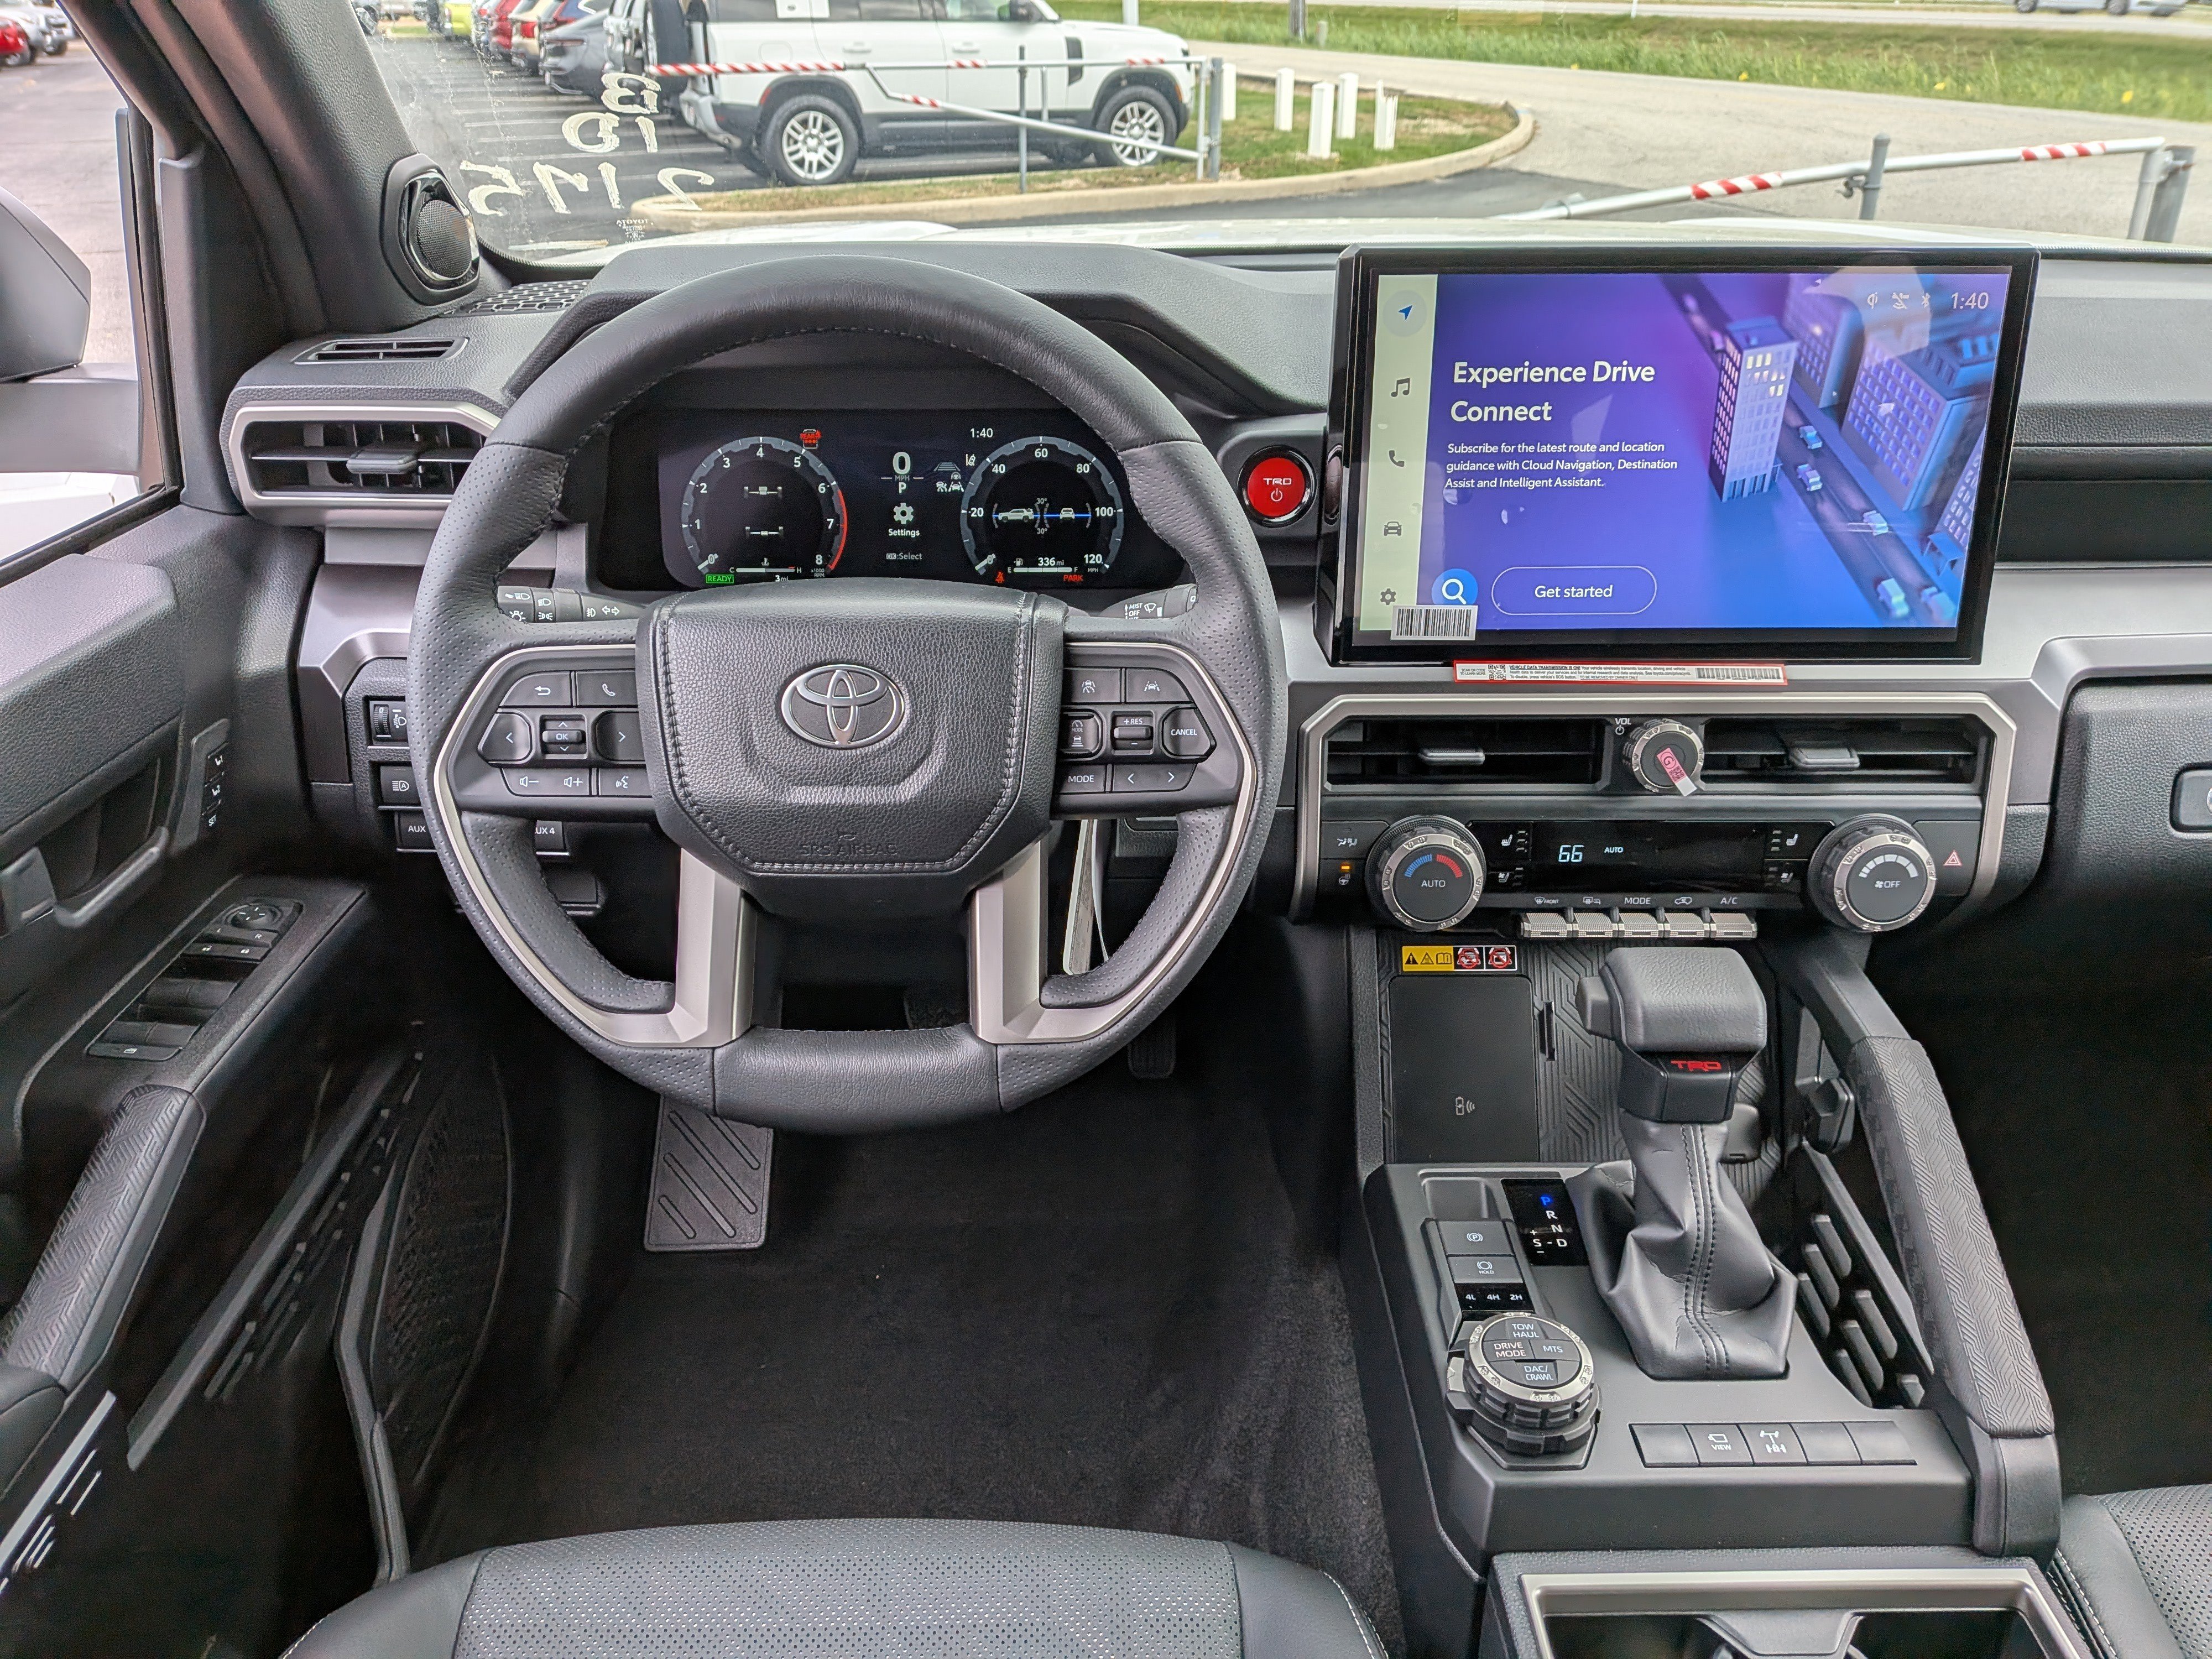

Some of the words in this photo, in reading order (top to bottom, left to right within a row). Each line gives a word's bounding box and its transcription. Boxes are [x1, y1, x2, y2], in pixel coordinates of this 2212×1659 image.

[1952, 292, 1989, 309] 1:40
[1454, 361, 1587, 388] Experience
[1593, 360, 1655, 382] Drive
[1451, 400, 1552, 422] Connect
[970, 427, 993, 437] 1:40
[1448, 443, 1498, 453] Subscribe
[1501, 442, 1516, 453] for
[1517, 442, 1535, 453] the
[1537, 442, 1566, 452] latest
[1569, 443, 1597, 452] route
[1599, 441, 1620, 452] and
[1621, 441, 1665, 452] location
[757, 448, 764, 457] 4
[1035, 448, 1048, 458] 60
[723, 458, 731, 468] 3
[794, 457, 801, 467] 5
[893, 451, 911, 474] 0
[1446, 461, 1495, 473] guidance
[1496, 460, 1519, 470] with
[1521, 460, 1553, 470] Cloud
[1556, 460, 1615, 472] Navigation,
[1618, 459, 1677, 469] Destination
[992, 464, 1006, 473] 40
[1076, 463, 1090, 473] 80
[700, 483, 707, 493] 2
[818, 483, 825, 493] 6
[899, 482, 906, 494] P
[1445, 478, 1475, 488] Assist
[1477, 477, 1497, 488] and
[1499, 477, 1552, 489] Intelligent
[1554, 477, 1604, 487] Assistant.
[971, 508, 984, 517] 20
[1095, 507, 1113, 516] 100
[695, 519, 701, 529] 1
[827, 519, 834, 529] 7
[888, 529, 920, 538] Settings
[708, 554, 715, 564] 0
[816, 555, 822, 565] 8
[987, 555, 994, 564] 0
[1084, 554, 1102, 564] 120
[1535, 585, 1561, 598] Get
[1563, 585, 1613, 598] started
[1663, 755, 1674, 766] G
[1558, 845, 1584, 862] 66
[1670, 1060, 1721, 1072] TRD
[1541, 1196, 1551, 1206] P
[1546, 1211, 1558, 1219] R
[1551, 1224, 1563, 1233] N
[1532, 1239, 1542, 1247] S
[1556, 1239, 1568, 1247] D
[1543, 1345, 1563, 1353] MTS
